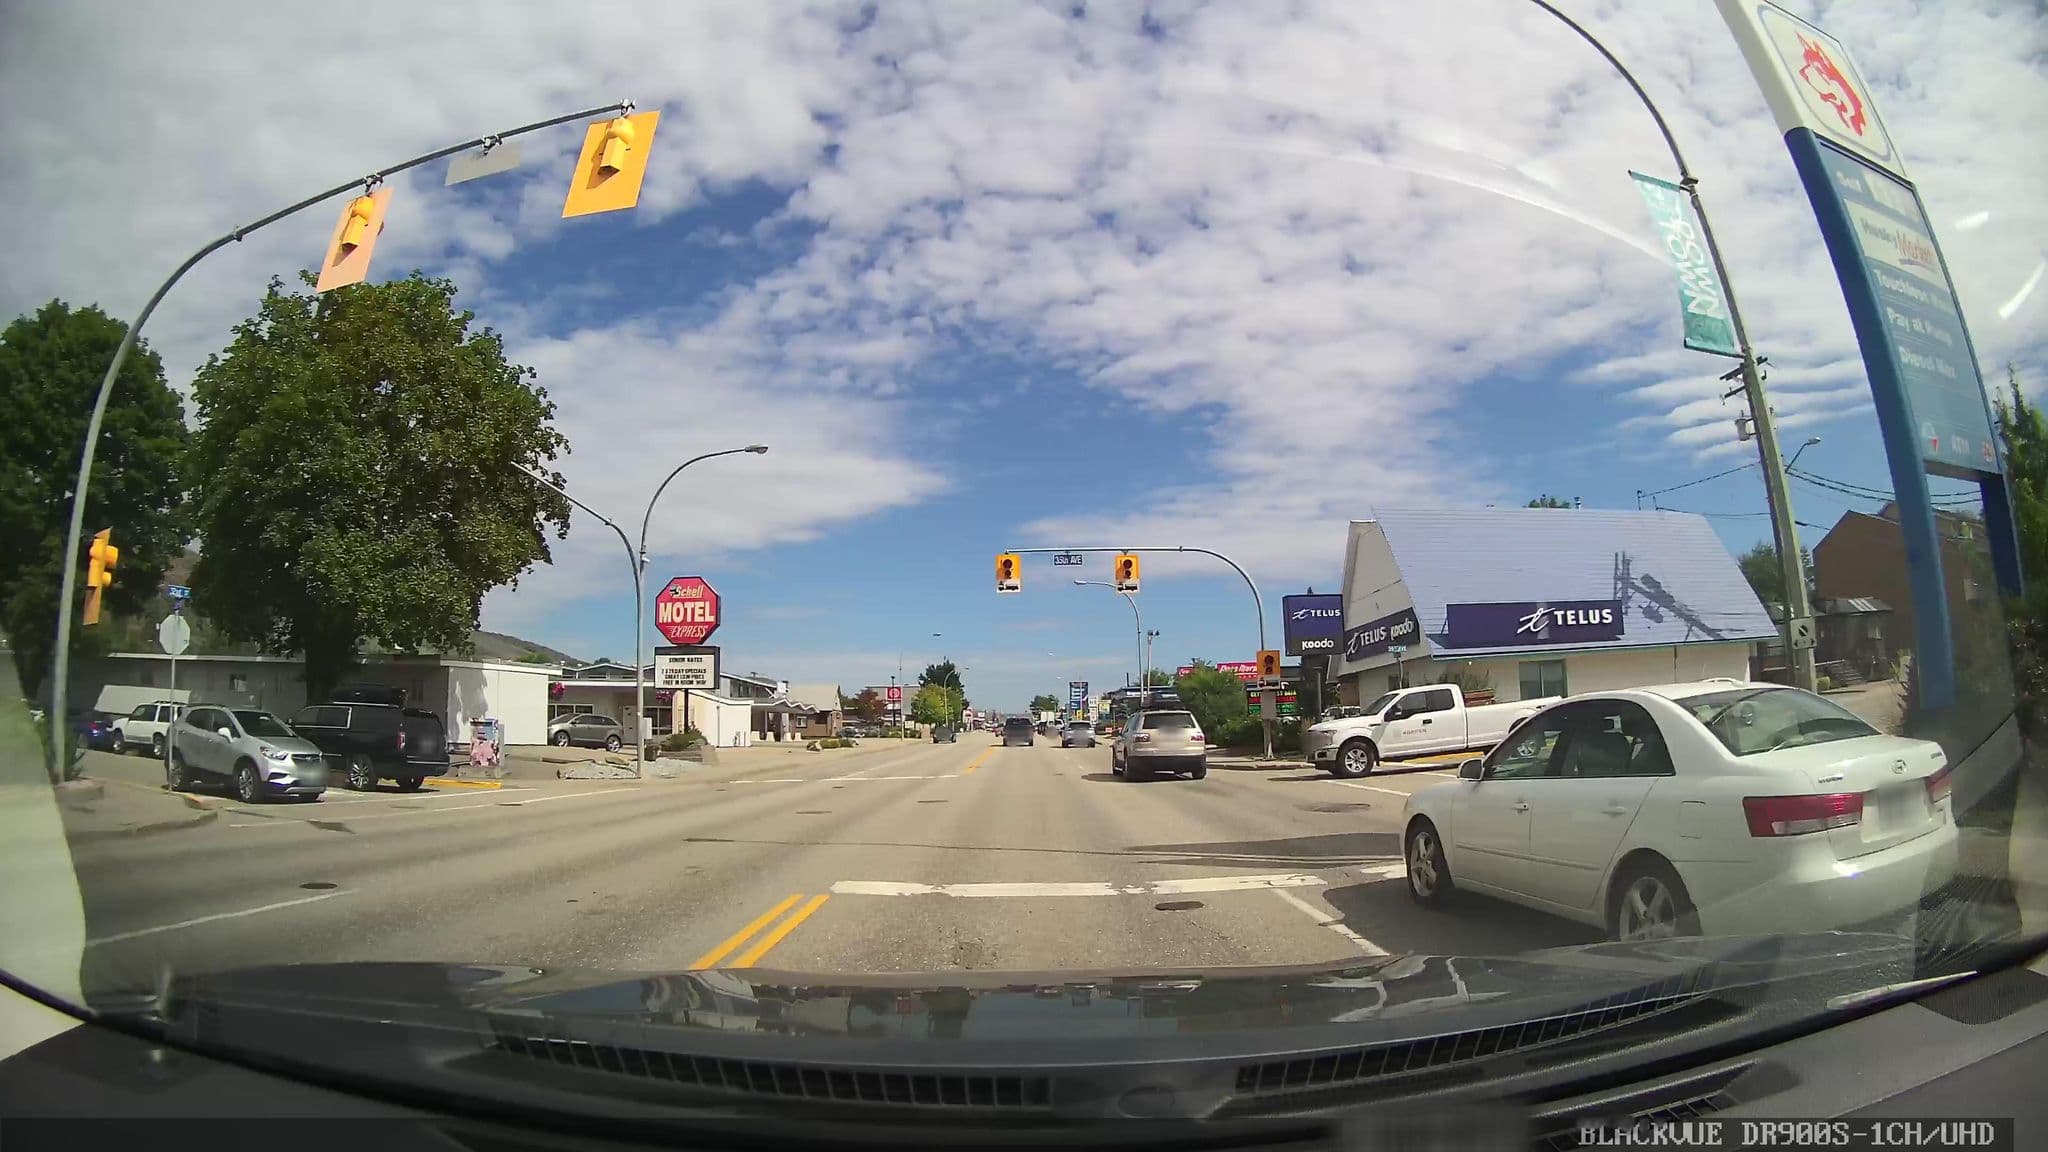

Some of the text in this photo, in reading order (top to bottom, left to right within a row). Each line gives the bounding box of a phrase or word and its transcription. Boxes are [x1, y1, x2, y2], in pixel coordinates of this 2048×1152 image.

[675, 585, 704, 597] Schell
[659, 601, 715, 623] MOTEL
[1310, 609, 1341, 617] TELUS
[1554, 608, 1613, 625] TELUS
[671, 625, 708, 638] EXPRESS
[1360, 626, 1387, 647] TELUS
